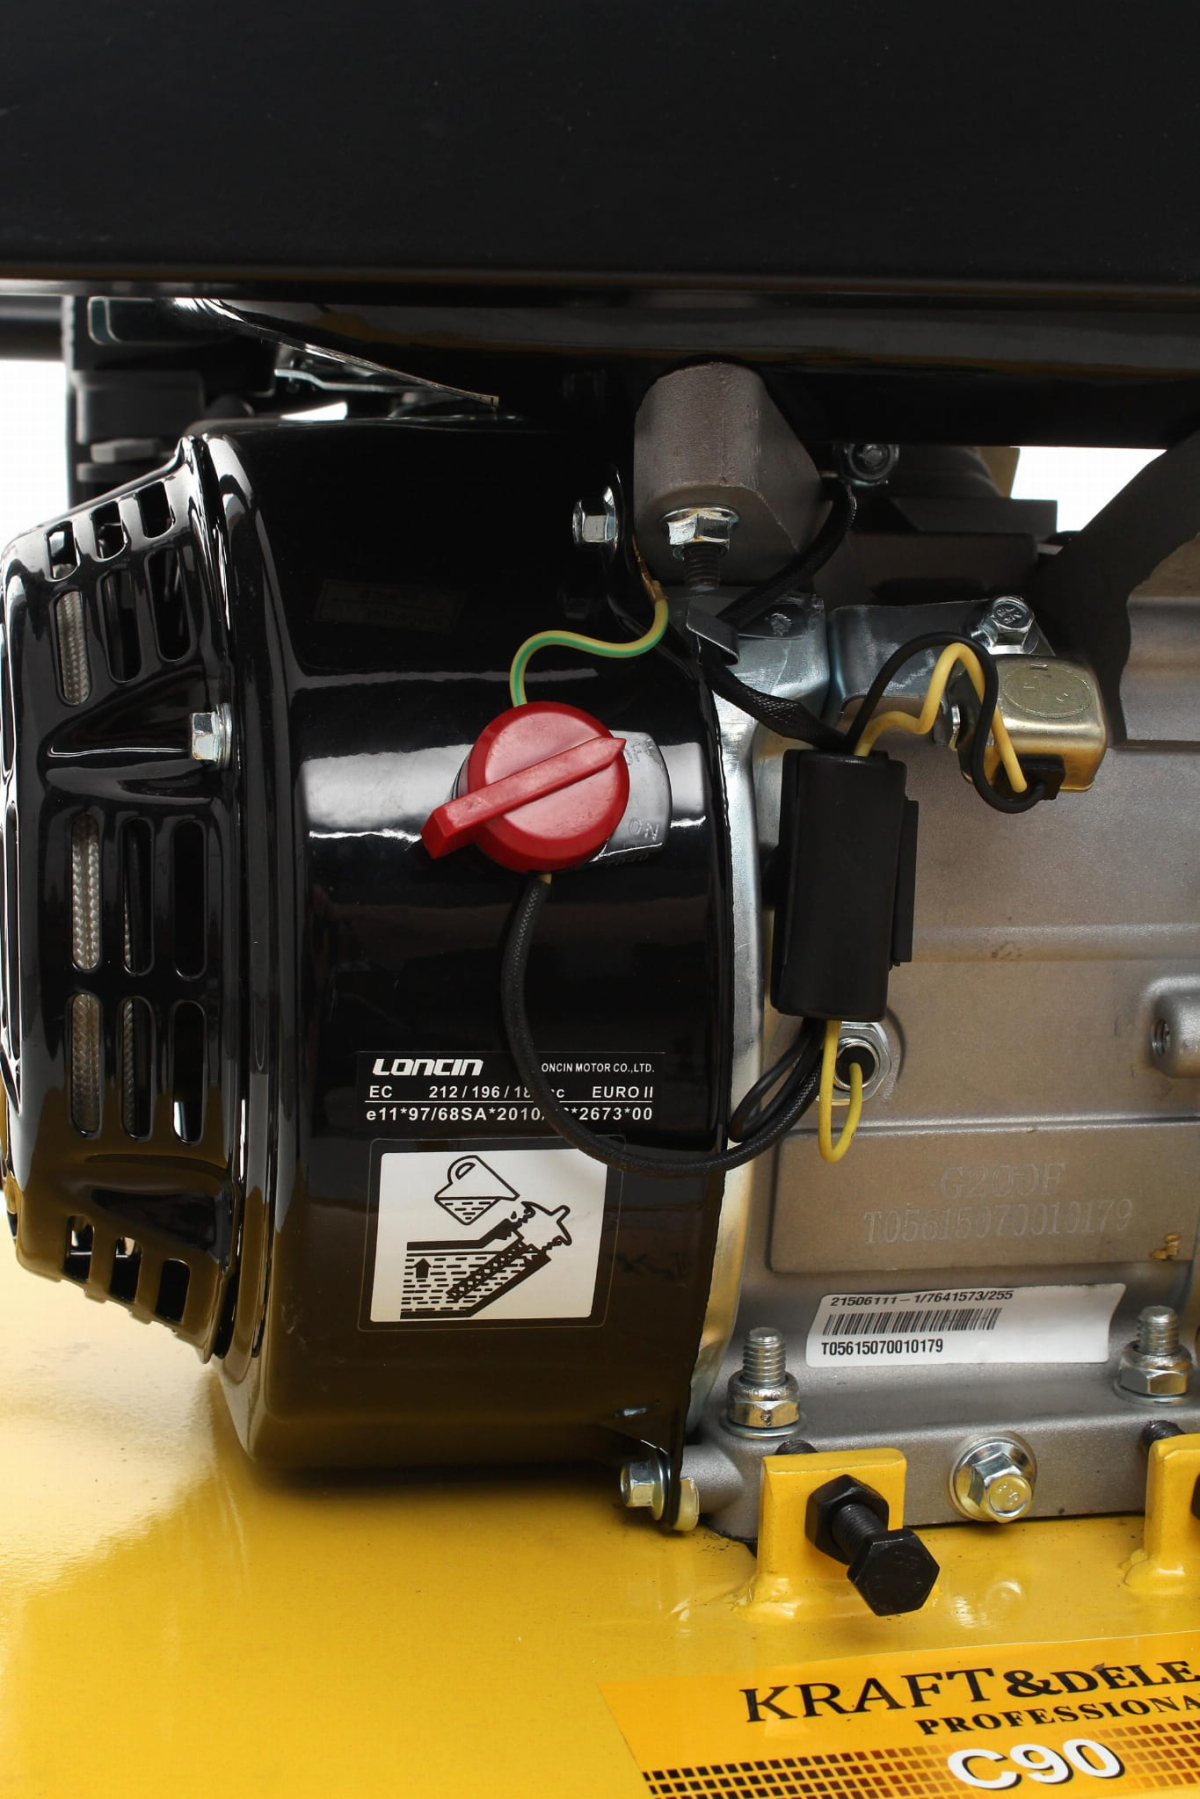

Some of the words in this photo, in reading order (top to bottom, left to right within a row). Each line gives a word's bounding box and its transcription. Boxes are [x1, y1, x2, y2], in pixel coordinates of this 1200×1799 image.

[628, 817, 660, 841] ON
[372, 1058, 484, 1077] LONCIN
[541, 1062, 573, 1073] ONCIN
[575, 1062, 611, 1073] MOTOR
[613, 1062, 655, 1075] CO.,LTD.
[369, 1085, 393, 1098] EC
[592, 1086, 640, 1099] EURO
[643, 1086, 654, 1098] II
[821, 1338, 944, 1356] T05615070010179
[915, 1693, 1200, 1736] PROFESSIONA
[947, 1738, 1126, 1791] C90
